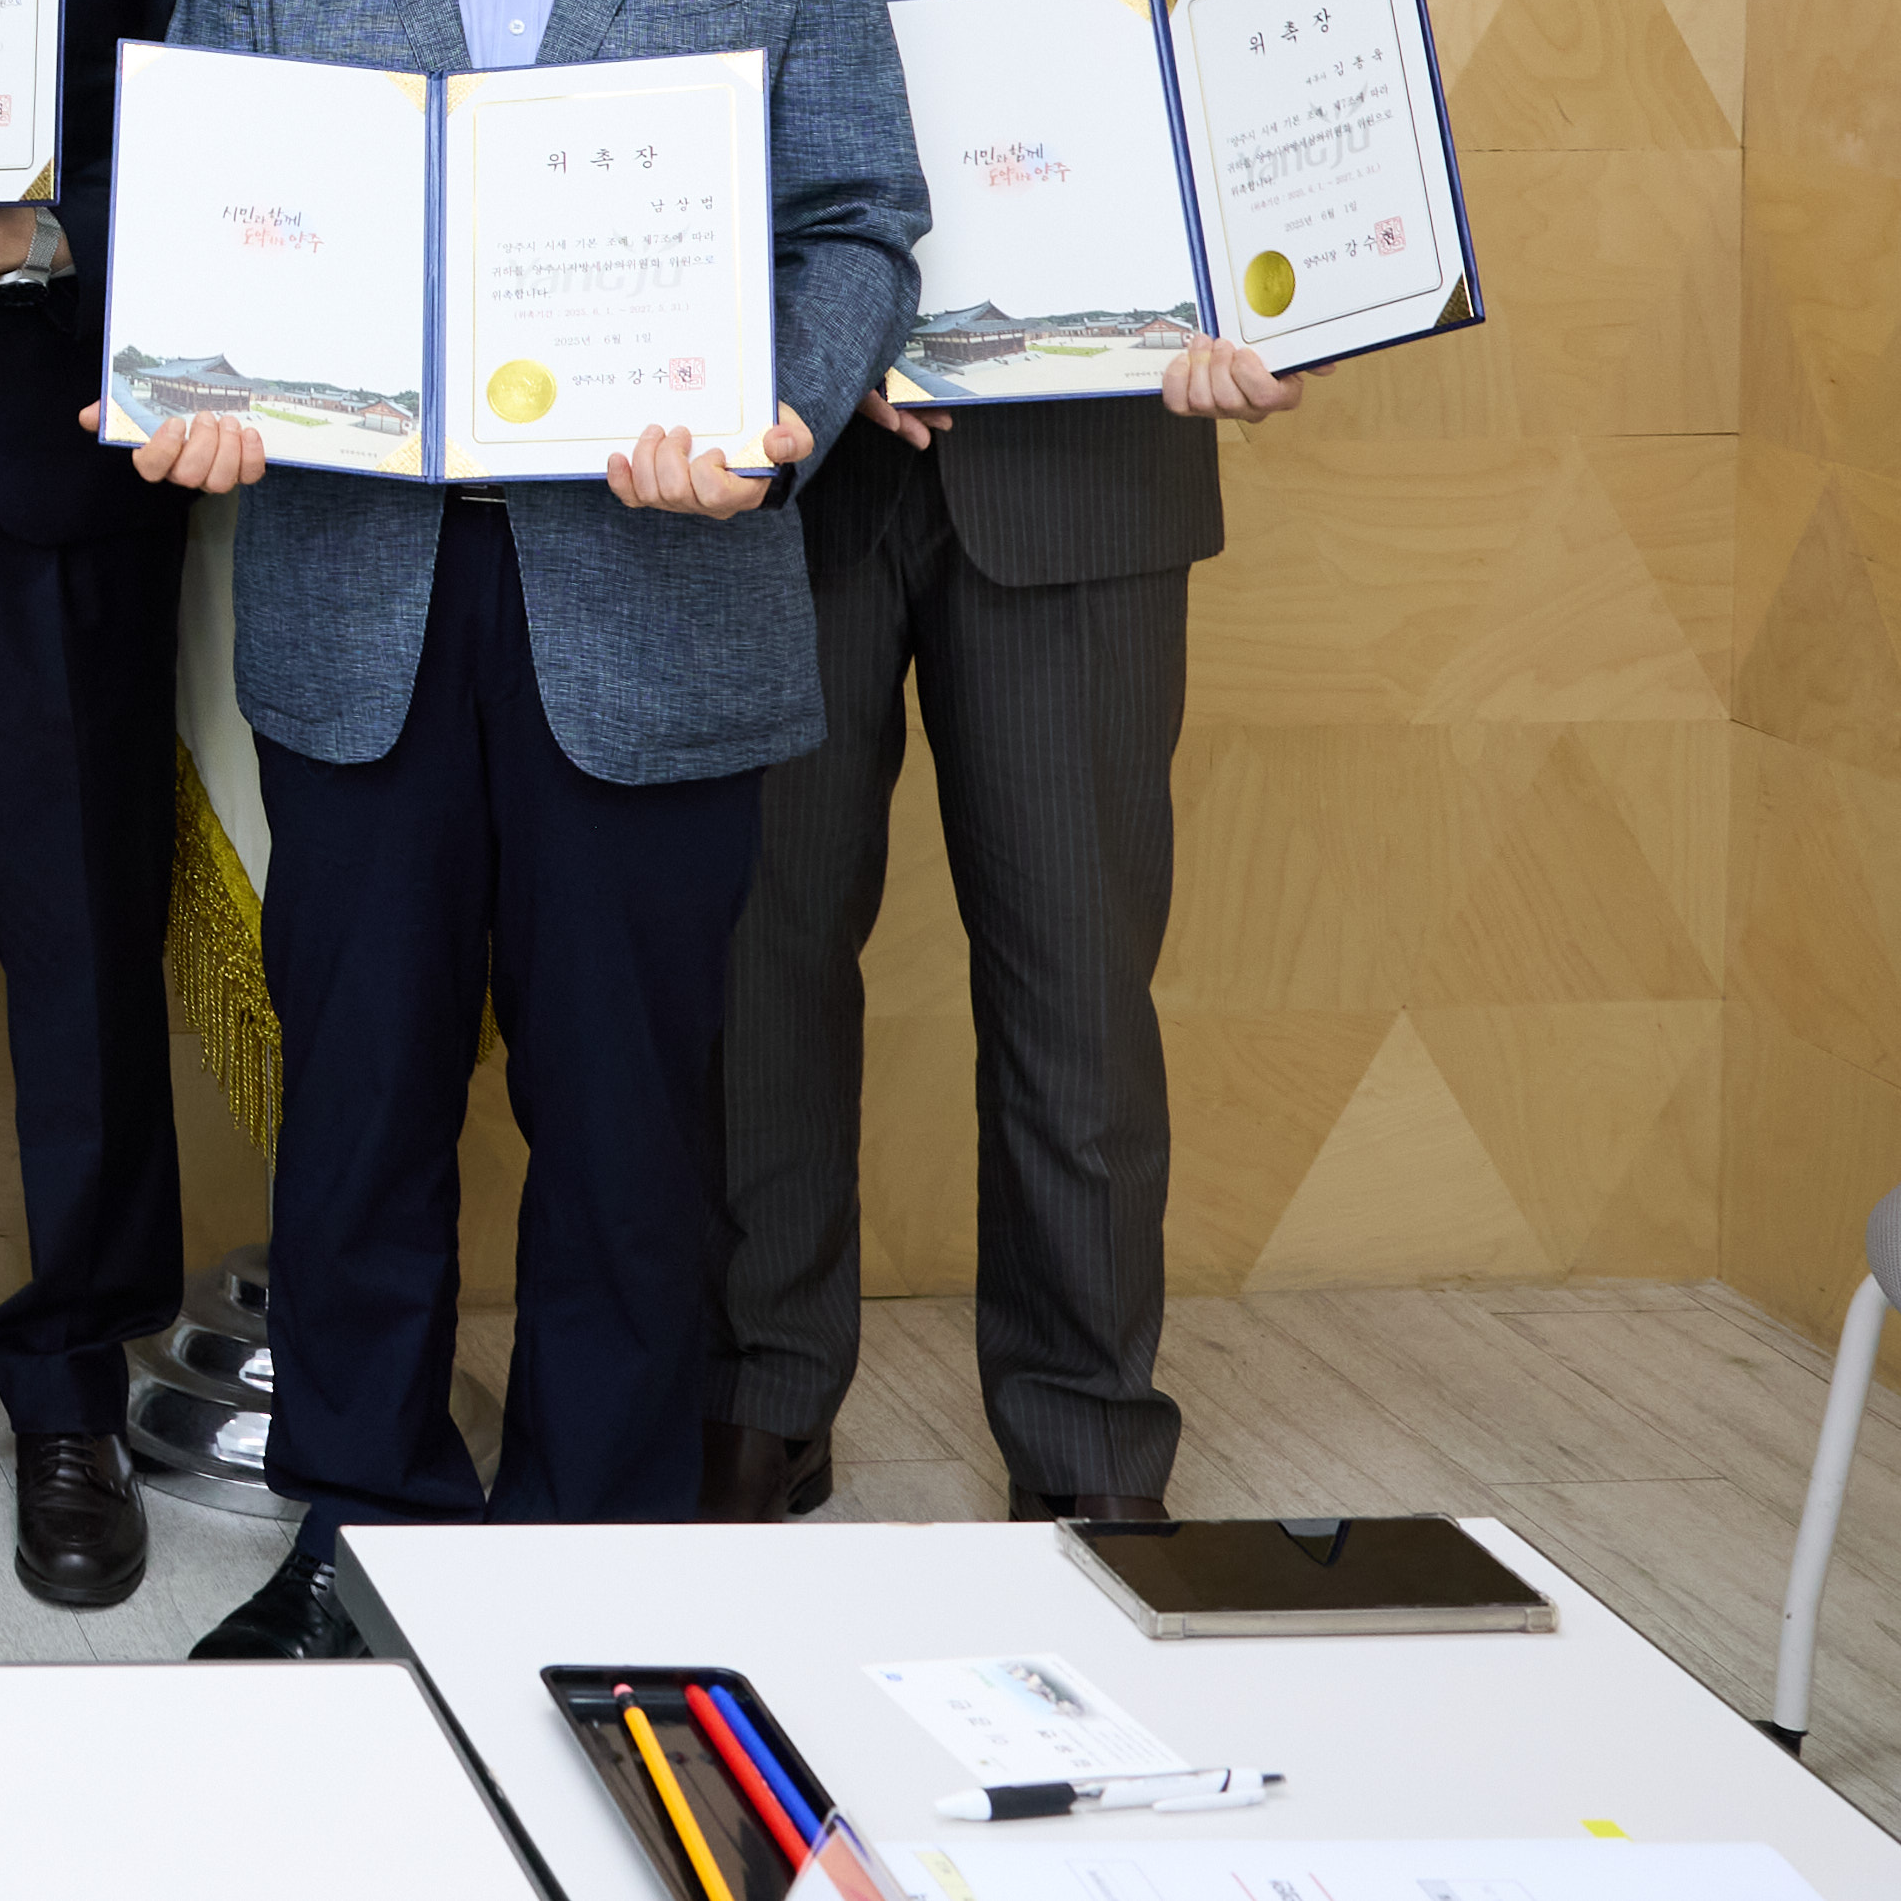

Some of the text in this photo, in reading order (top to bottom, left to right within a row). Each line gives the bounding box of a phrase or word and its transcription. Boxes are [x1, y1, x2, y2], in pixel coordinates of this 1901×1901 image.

[1034, 162, 1071, 182] 양주
[268, 207, 301, 227] 함께
[289, 230, 325, 254] 양주
[692, 231, 714, 242] 따라
